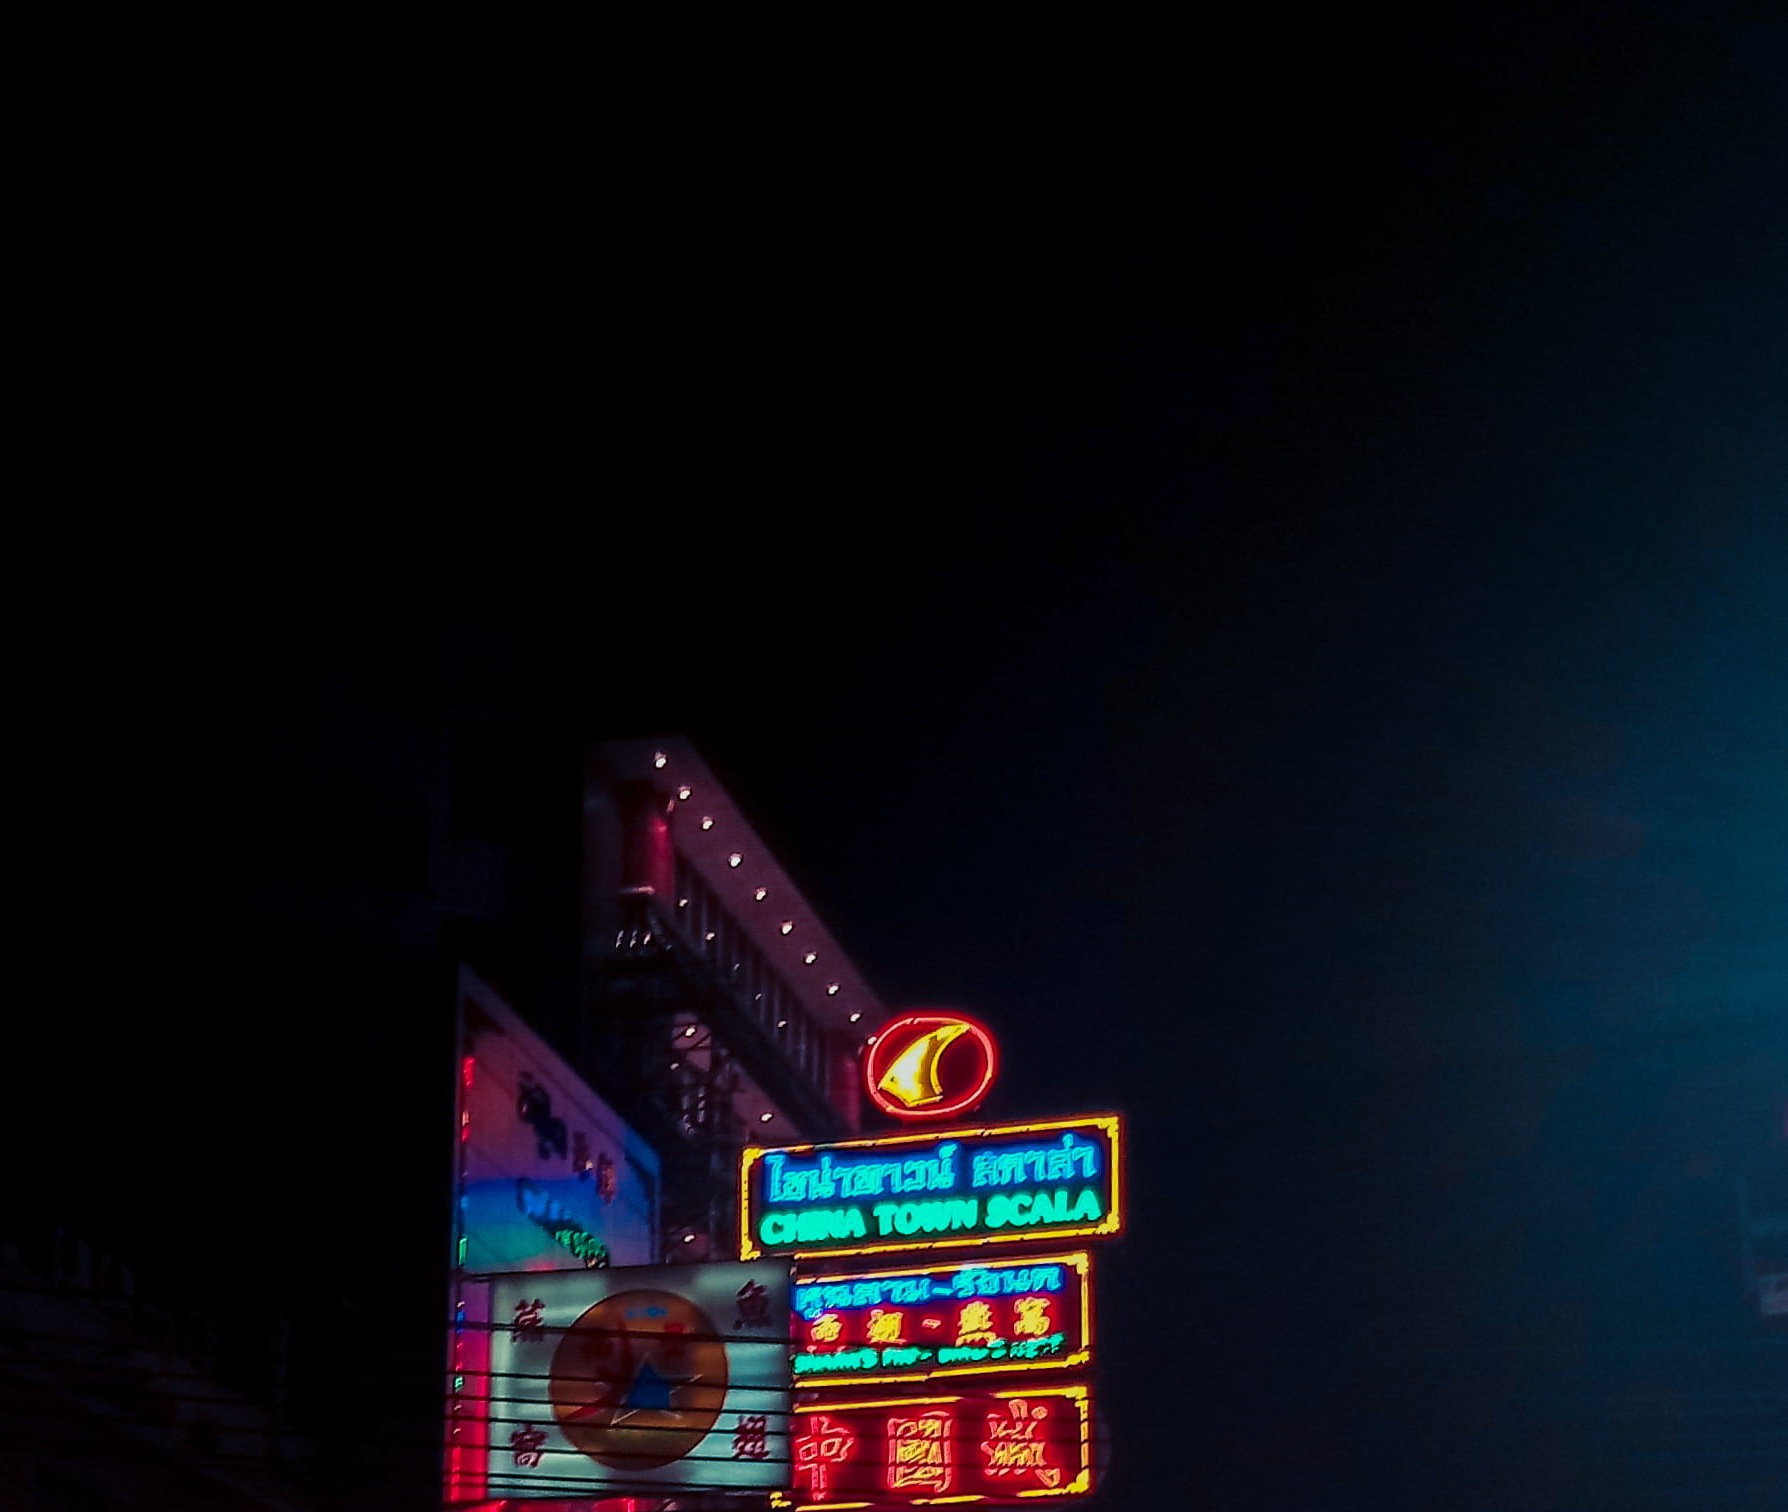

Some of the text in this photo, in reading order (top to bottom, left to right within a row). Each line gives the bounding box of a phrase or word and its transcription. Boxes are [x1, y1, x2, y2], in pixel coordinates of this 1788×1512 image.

[760, 1190, 1101, 1245] CHINA TOWN SCALA
